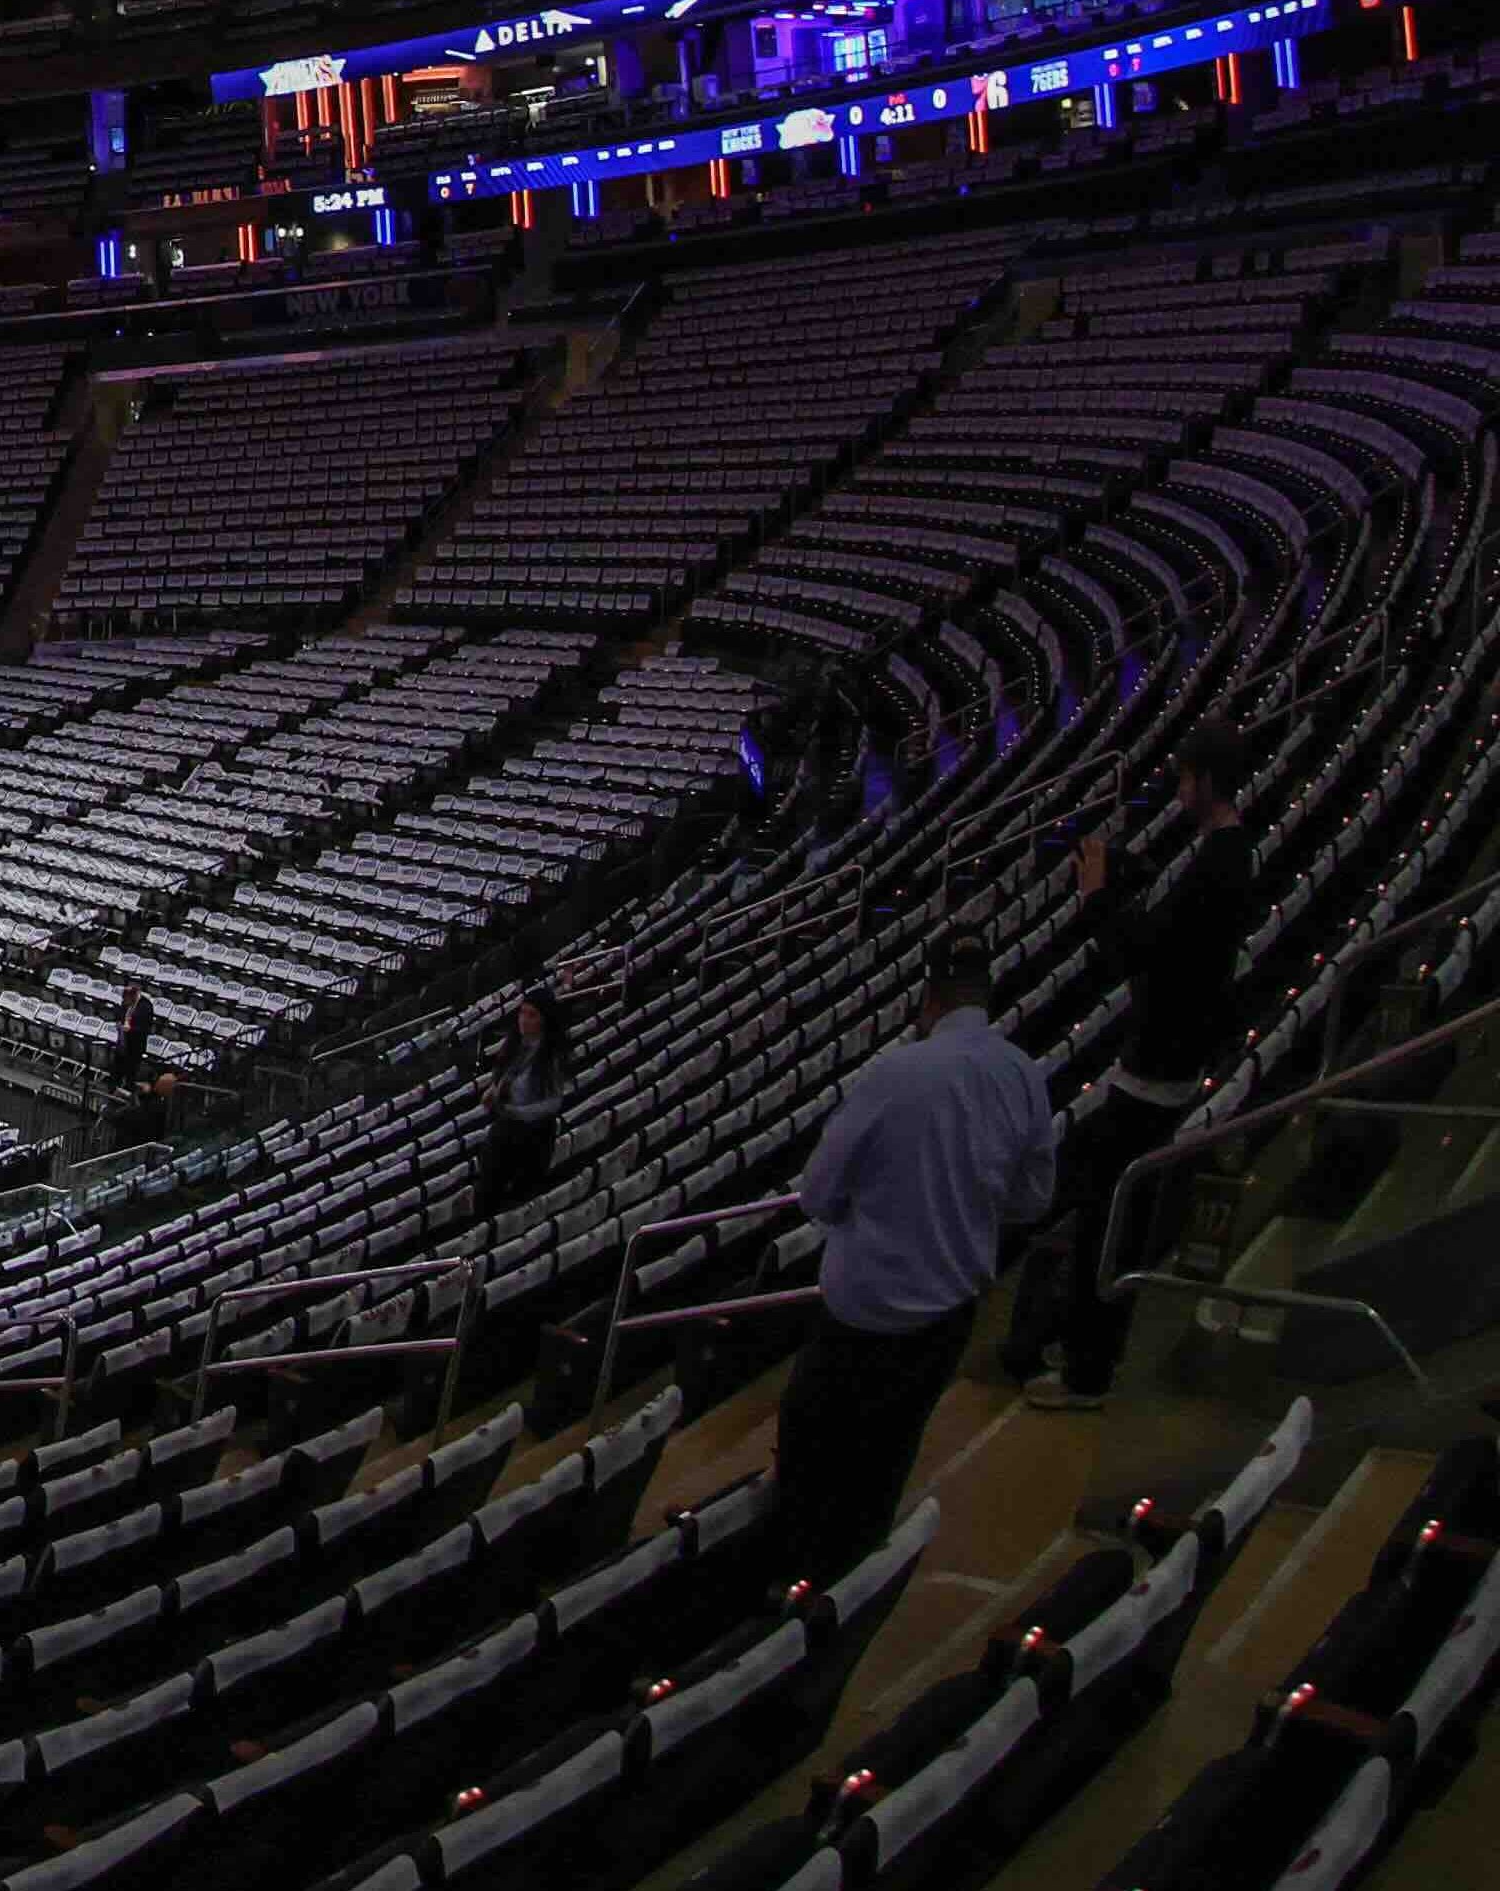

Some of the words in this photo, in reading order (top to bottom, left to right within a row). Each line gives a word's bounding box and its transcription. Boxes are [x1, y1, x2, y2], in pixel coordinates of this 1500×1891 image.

[970, 70, 1009, 111] 76
[1030, 67, 1069, 94] 76ERS
[932, 88, 947, 109] 0
[849, 106, 863, 125] 0
[879, 103, 915, 126] 4:11
[312, 192, 352, 214] 5:24
[355, 187, 386, 207] PM
[287, 289, 338, 315] NEW
[350, 280, 411, 308] YORK
